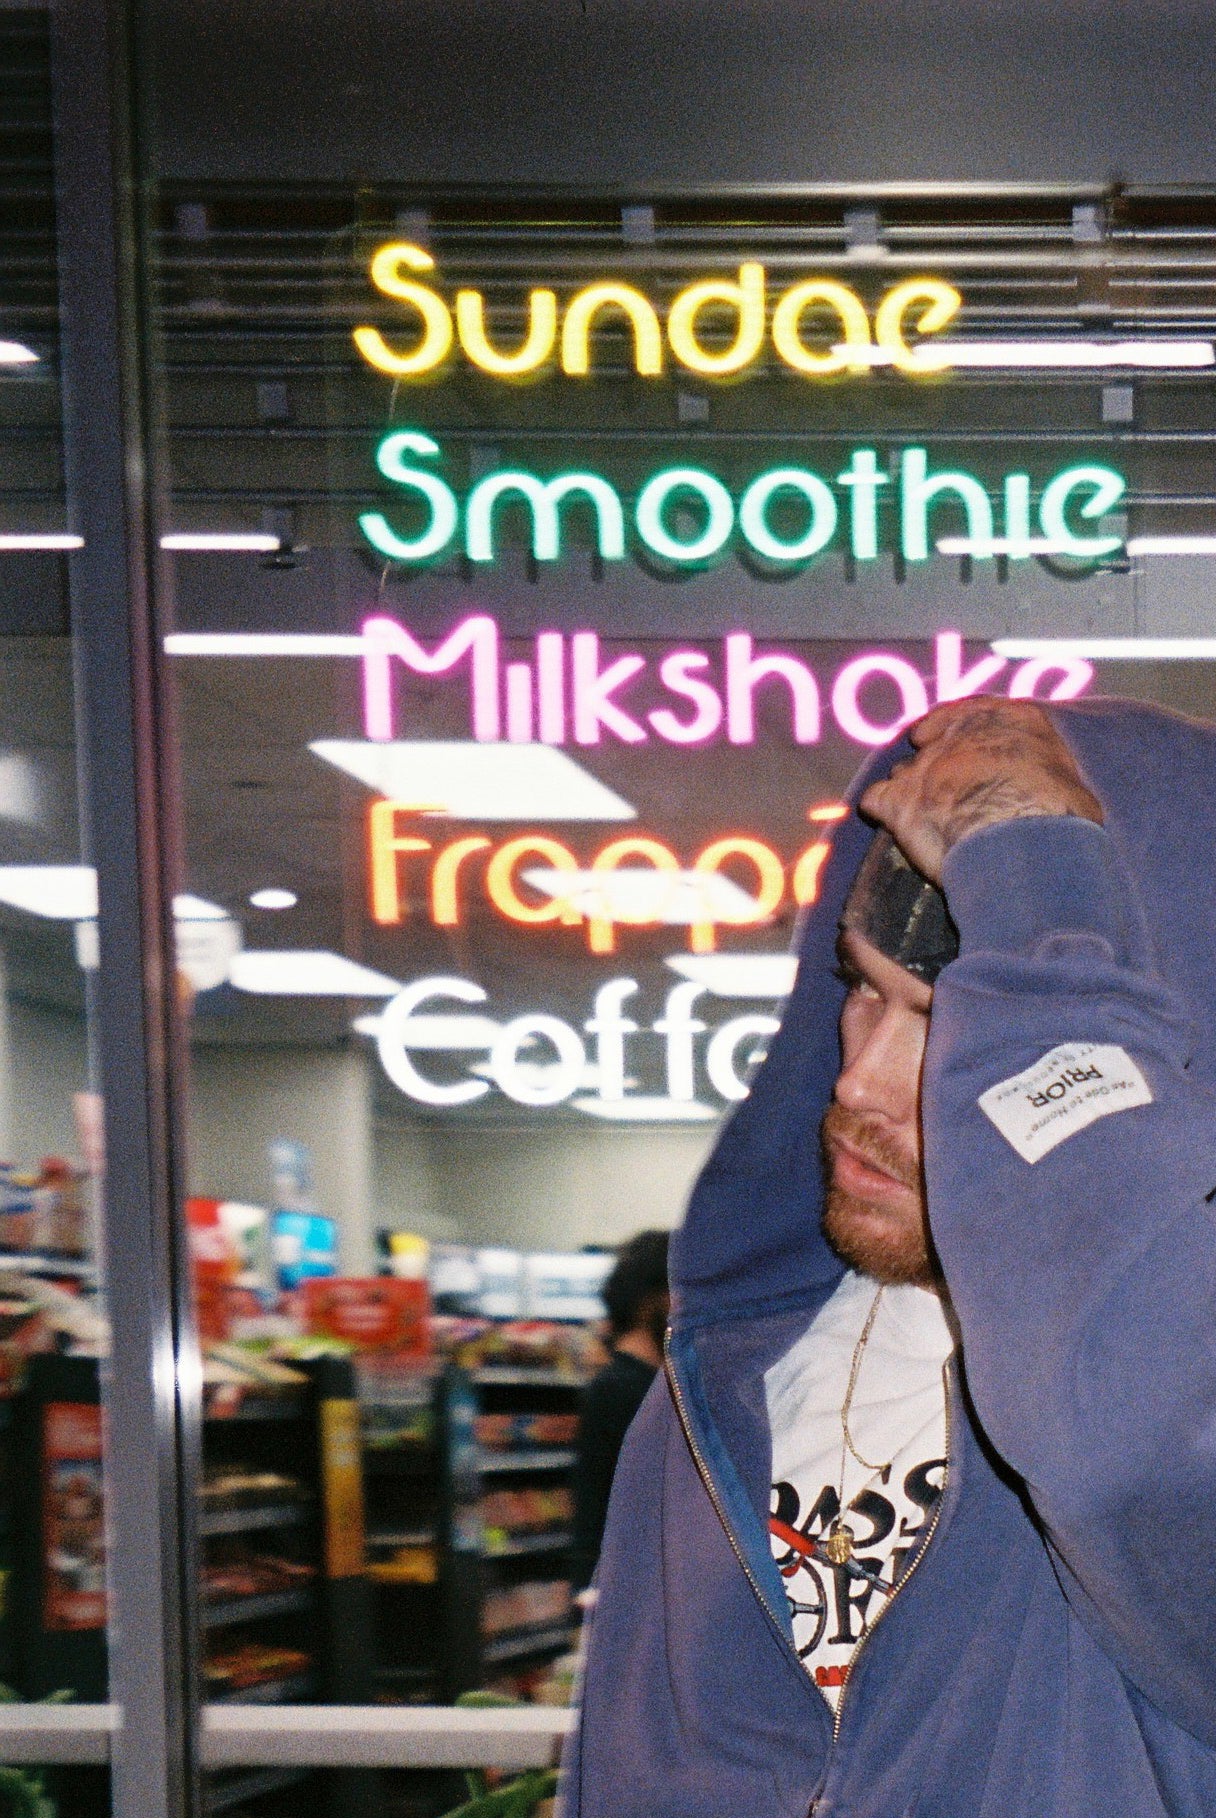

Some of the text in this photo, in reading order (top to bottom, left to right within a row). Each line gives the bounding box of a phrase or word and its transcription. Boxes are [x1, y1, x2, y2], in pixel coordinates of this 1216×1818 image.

[353, 243, 962, 376] Sundae
[358, 432, 1126, 561] Smoothie
[1025, 1063, 1104, 1108] PRIOR
